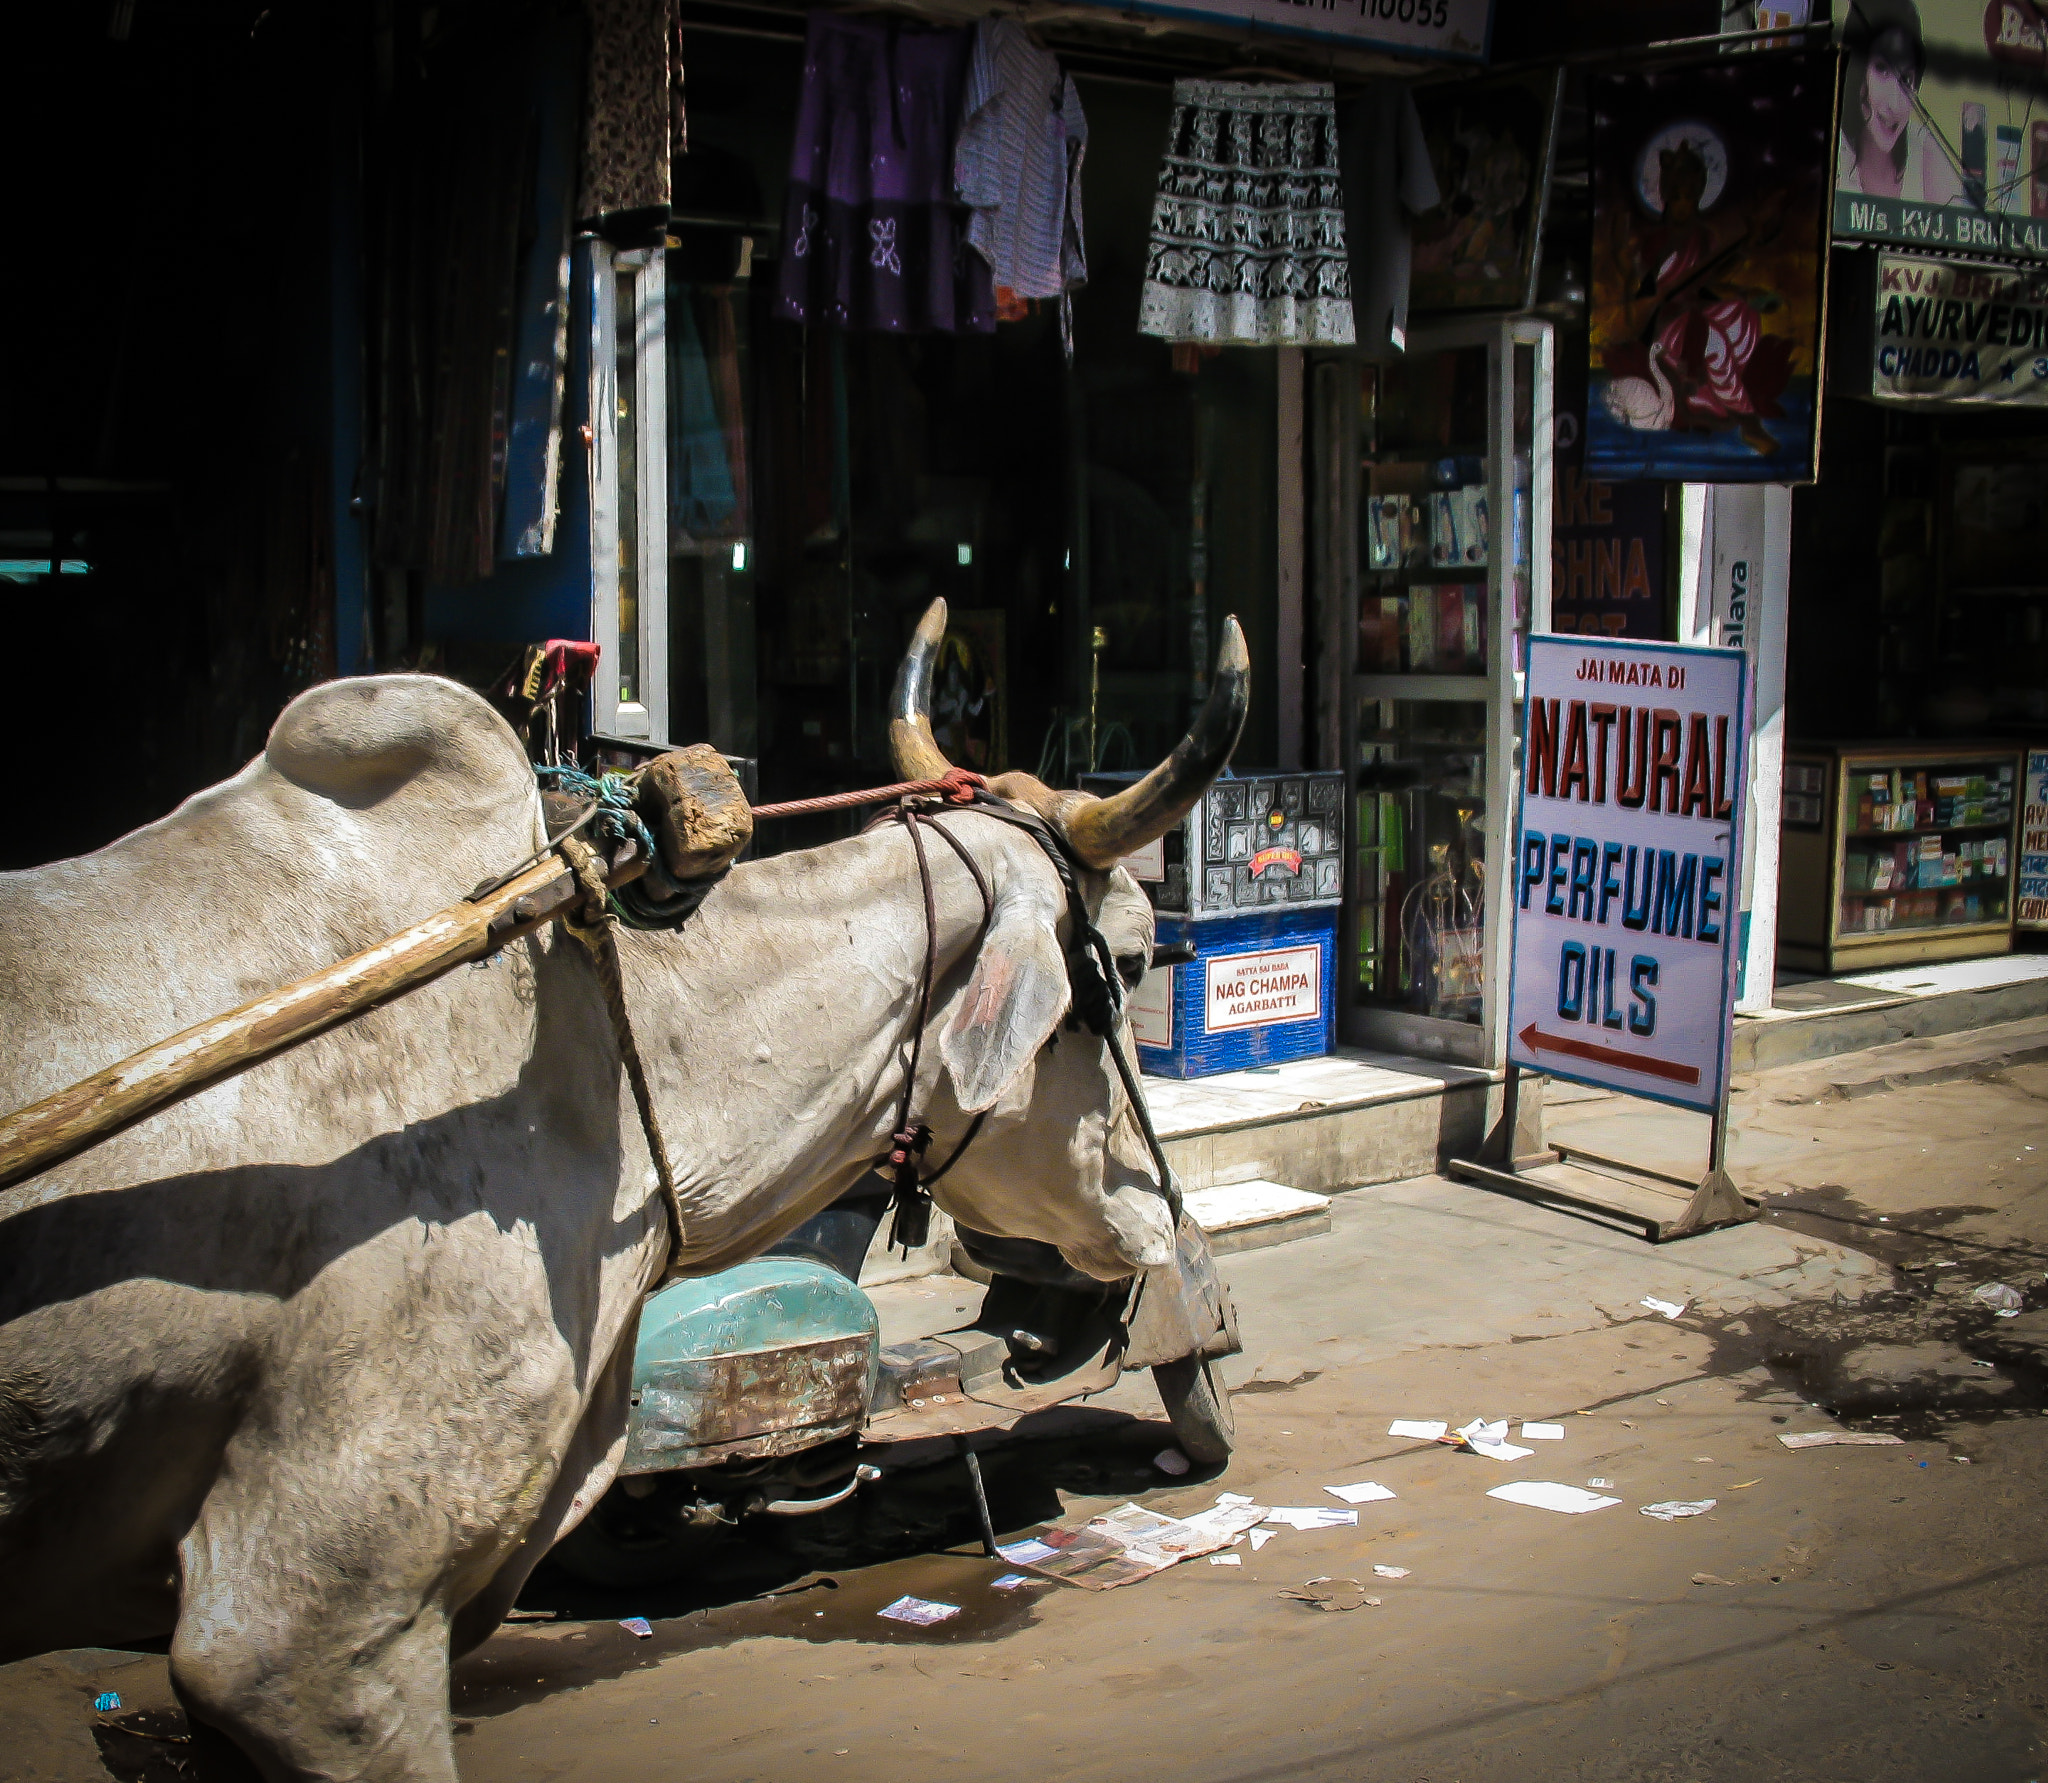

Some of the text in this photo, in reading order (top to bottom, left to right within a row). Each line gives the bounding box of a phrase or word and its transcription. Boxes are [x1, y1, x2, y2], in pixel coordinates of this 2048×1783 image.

[1881, 294, 2048, 350] AYURVEDI
[1879, 346, 1981, 381] CHADDA
[1575, 658, 1686, 690] JAI MATA DI
[1526, 696, 1733, 822] NATURAL
[1518, 829, 1726, 945] PERFUME
[1216, 973, 1309, 1000] NAG CHAMPA
[1228, 994, 1297, 1016] AGARBATTI
[1556, 940, 1661, 1038] OILS
